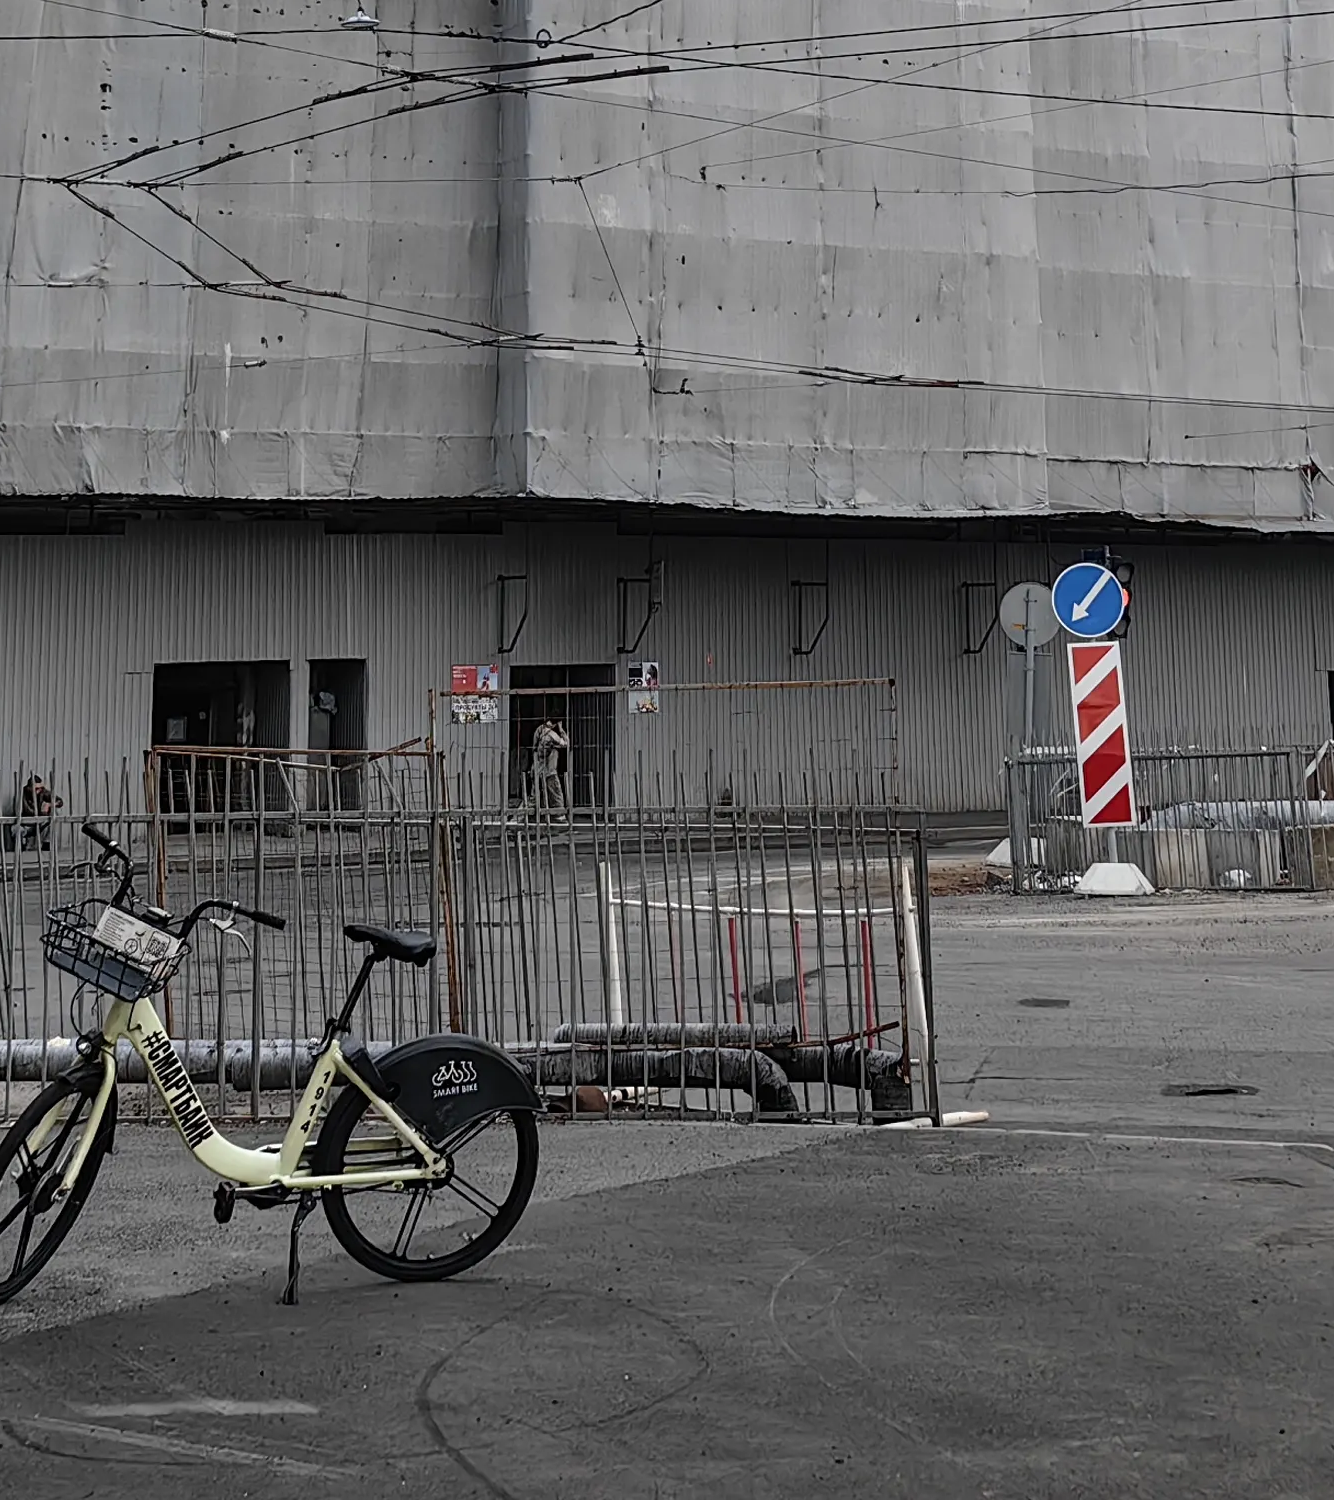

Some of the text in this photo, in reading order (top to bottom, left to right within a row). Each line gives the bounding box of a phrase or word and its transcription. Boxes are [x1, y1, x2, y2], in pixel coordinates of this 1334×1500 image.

[141, 1030, 214, 1150] #СМАРТБАНК
[300, 1071, 331, 1134] 1914
[433, 1083, 478, 1098] SMART BIKE
